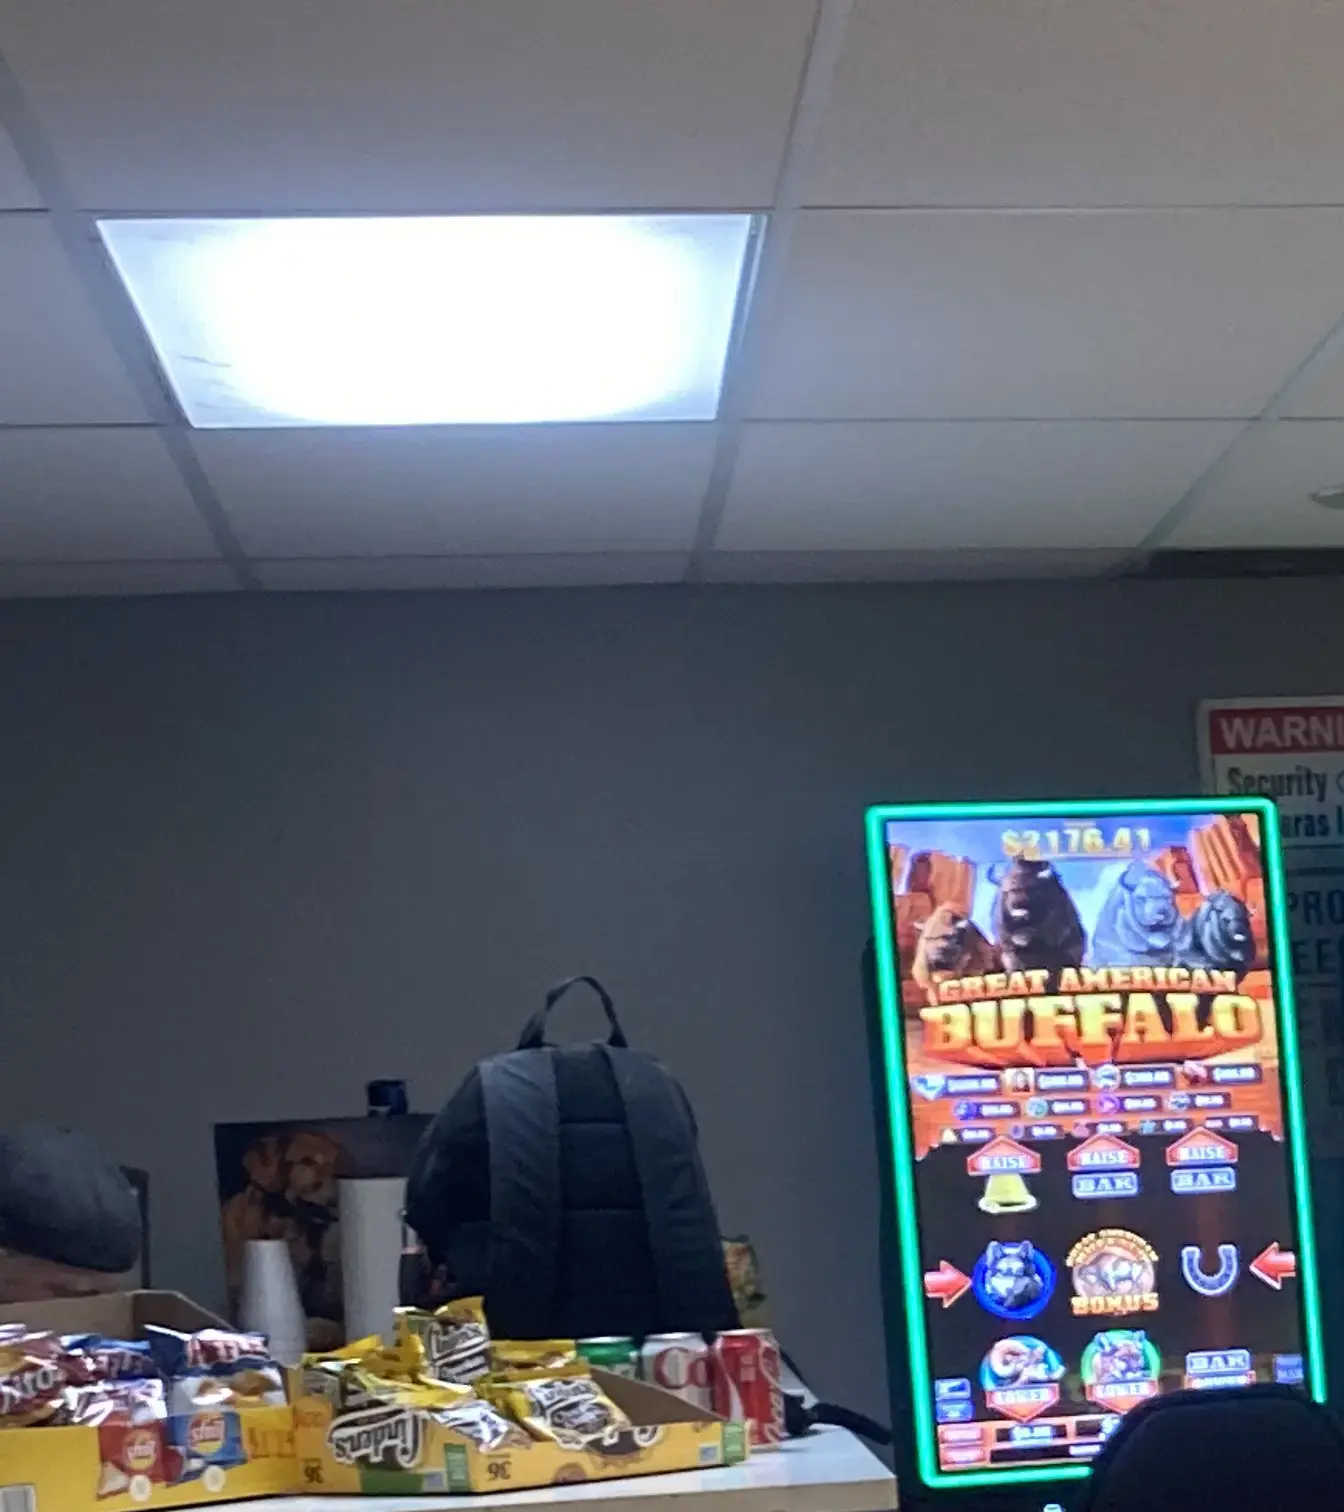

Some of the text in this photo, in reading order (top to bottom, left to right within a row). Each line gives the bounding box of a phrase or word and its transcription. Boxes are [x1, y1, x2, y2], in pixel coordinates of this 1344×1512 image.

[1228, 764, 1328, 803] Security
[935, 966, 1237, 1001] GREAT AMERICAN
[920, 992, 1262, 1054] BUFFALO
[1071, 1292, 1159, 1315] BONUS
